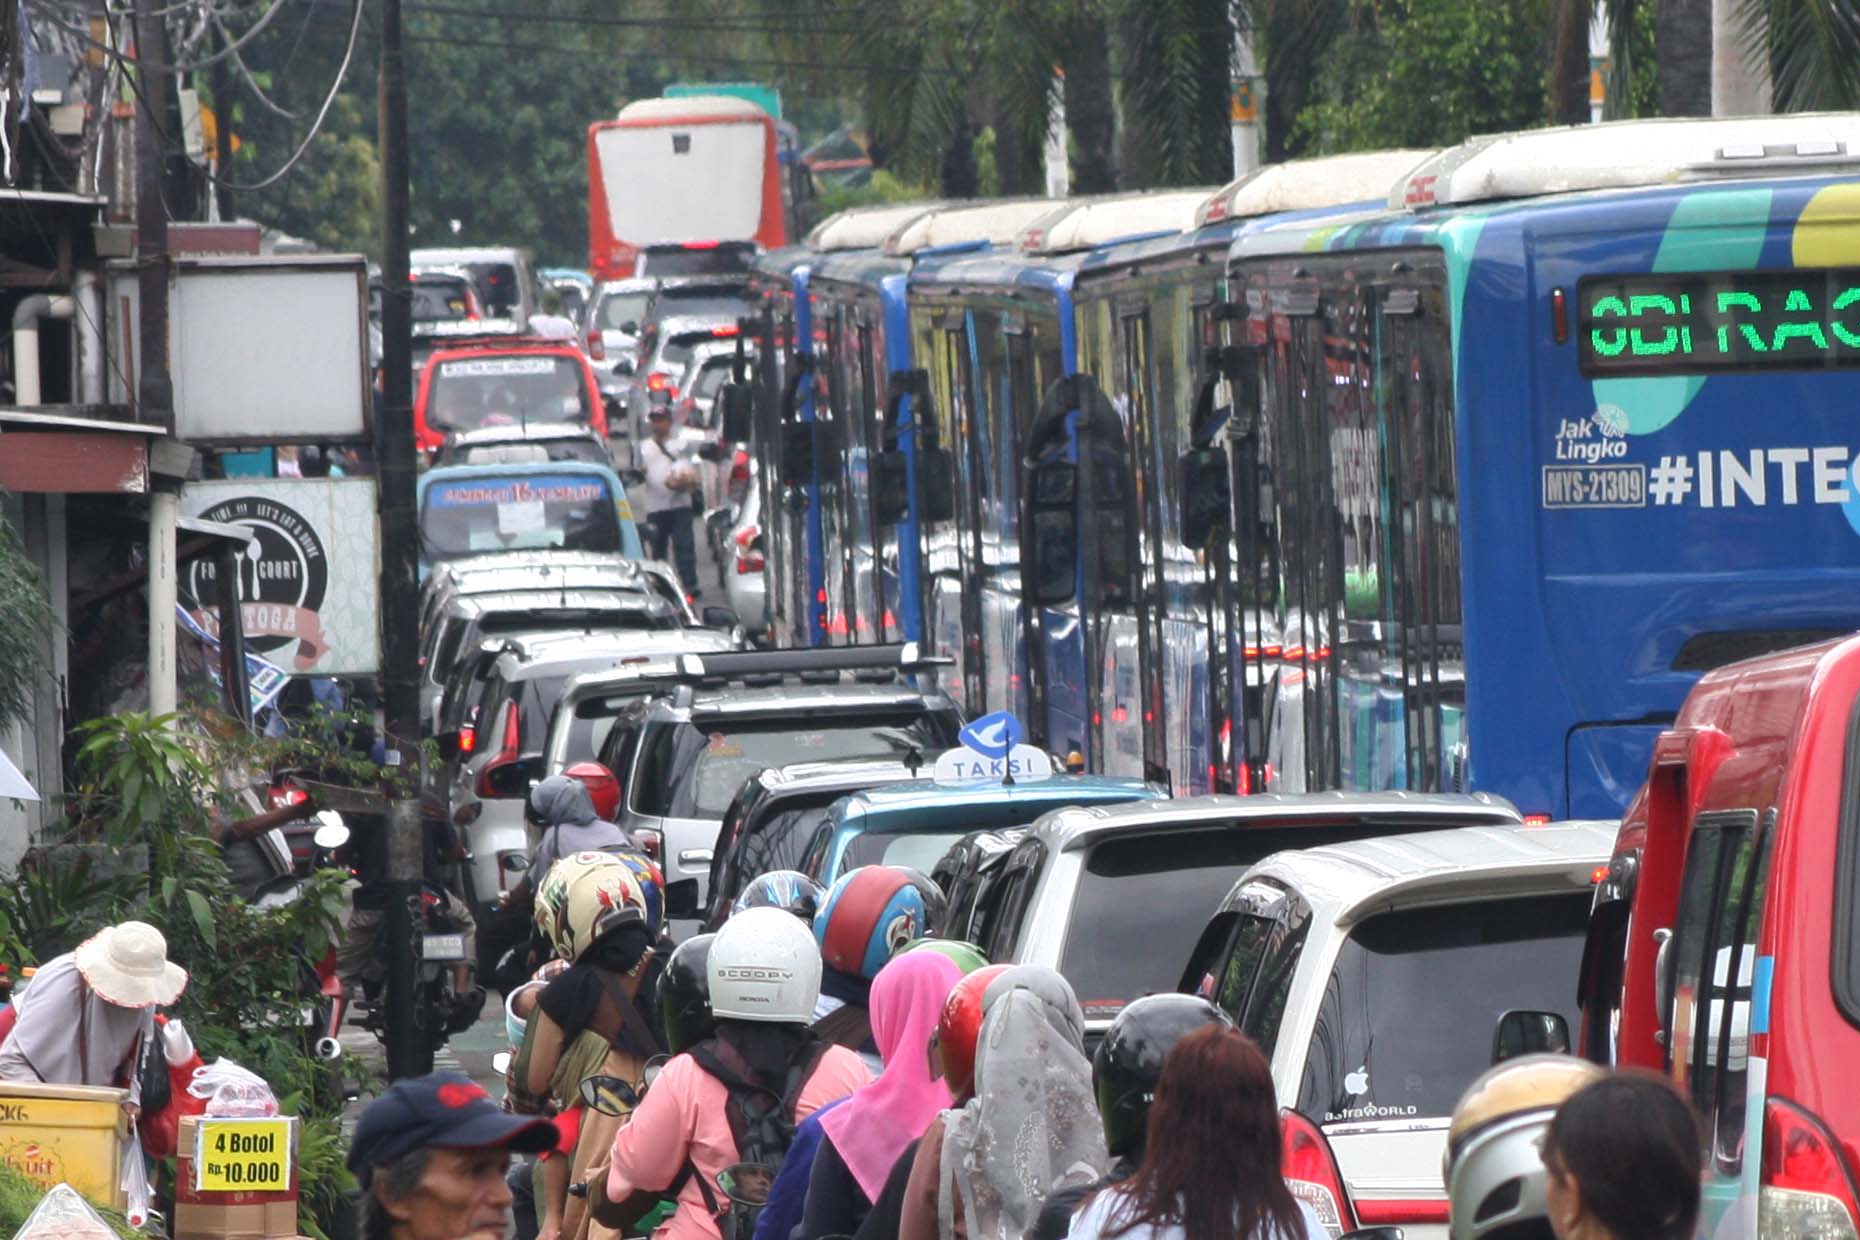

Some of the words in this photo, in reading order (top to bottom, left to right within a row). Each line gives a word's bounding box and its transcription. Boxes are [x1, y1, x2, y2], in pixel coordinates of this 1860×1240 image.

[1555, 418, 1593, 440] Jak
[1555, 438, 1628, 464] Lingko
[1547, 470, 1642, 502] MYS-21309
[259, 560, 298, 579] COURT
[953, 757, 1033, 777] TAKSI
[215, 1133, 226, 1153] 4
[229, 1132, 275, 1153] Botol
